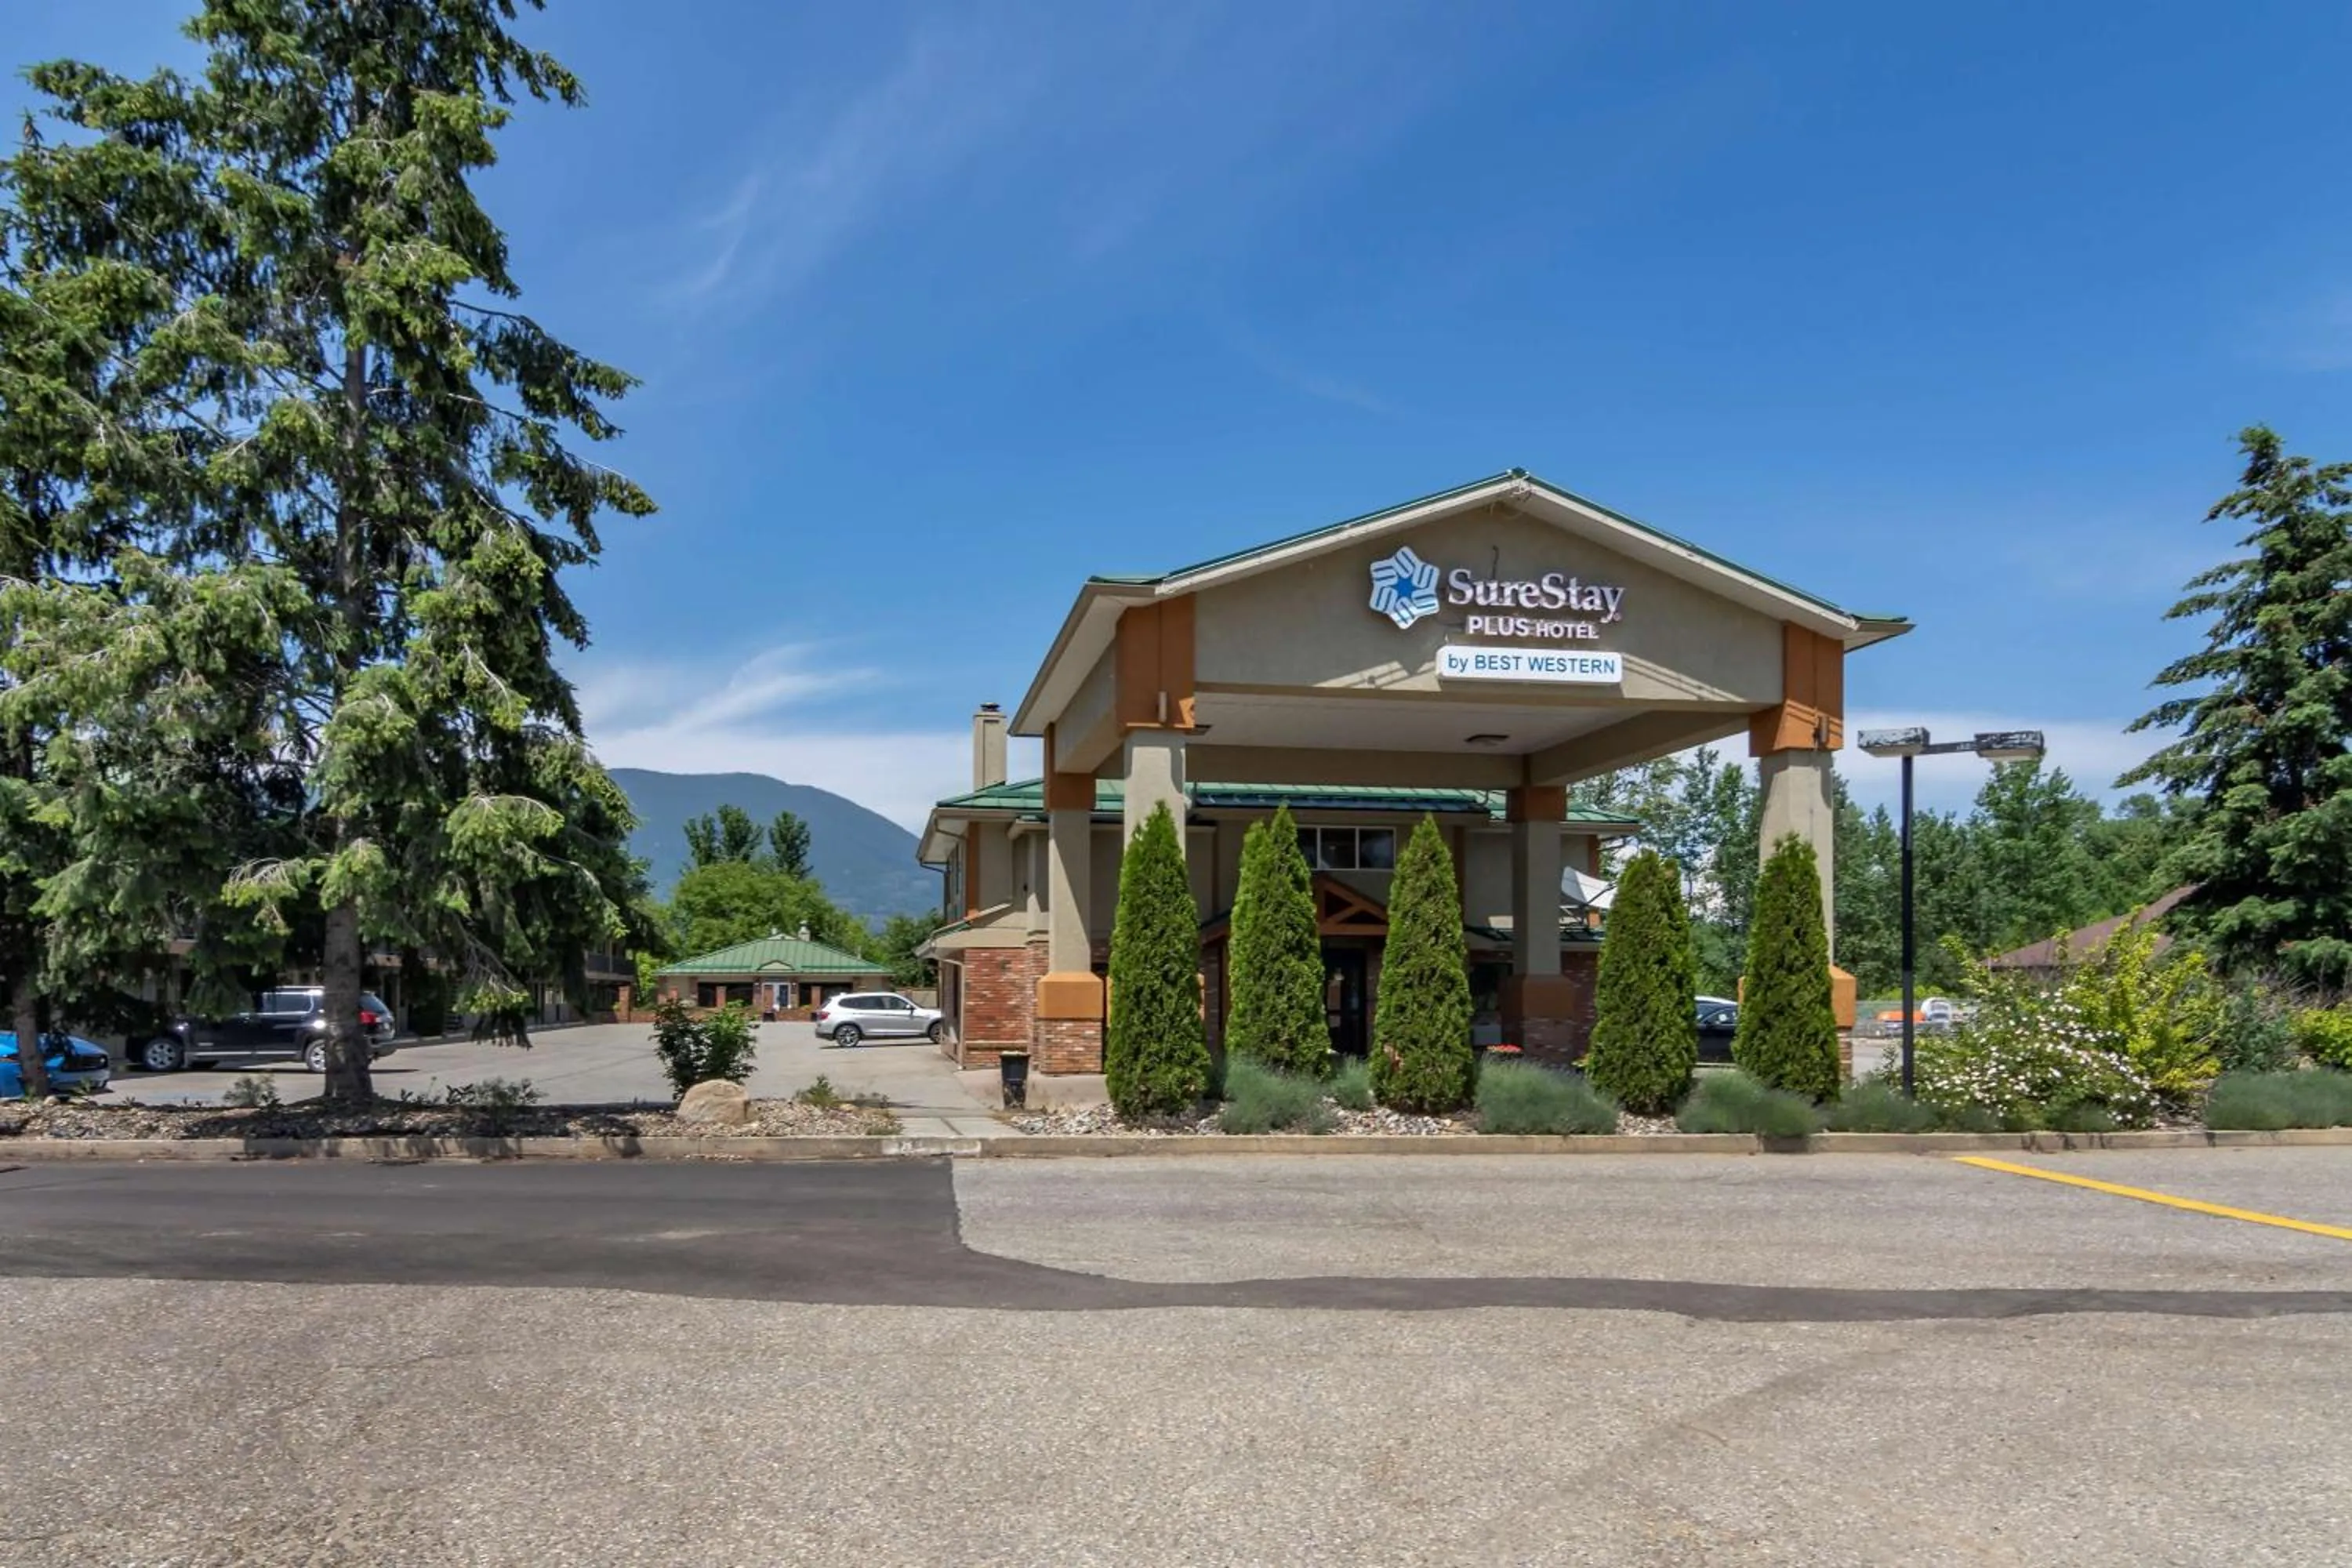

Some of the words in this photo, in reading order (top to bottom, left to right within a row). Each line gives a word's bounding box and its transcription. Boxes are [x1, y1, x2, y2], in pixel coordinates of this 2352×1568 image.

[1448, 568, 1624, 623] SureStay
[1467, 615, 1530, 637] PLUS
[1535, 622, 1600, 640] HOTEL
[1448, 654, 1468, 673] by
[1475, 655, 1523, 671] BEST
[1529, 656, 1615, 674] WESTERN
